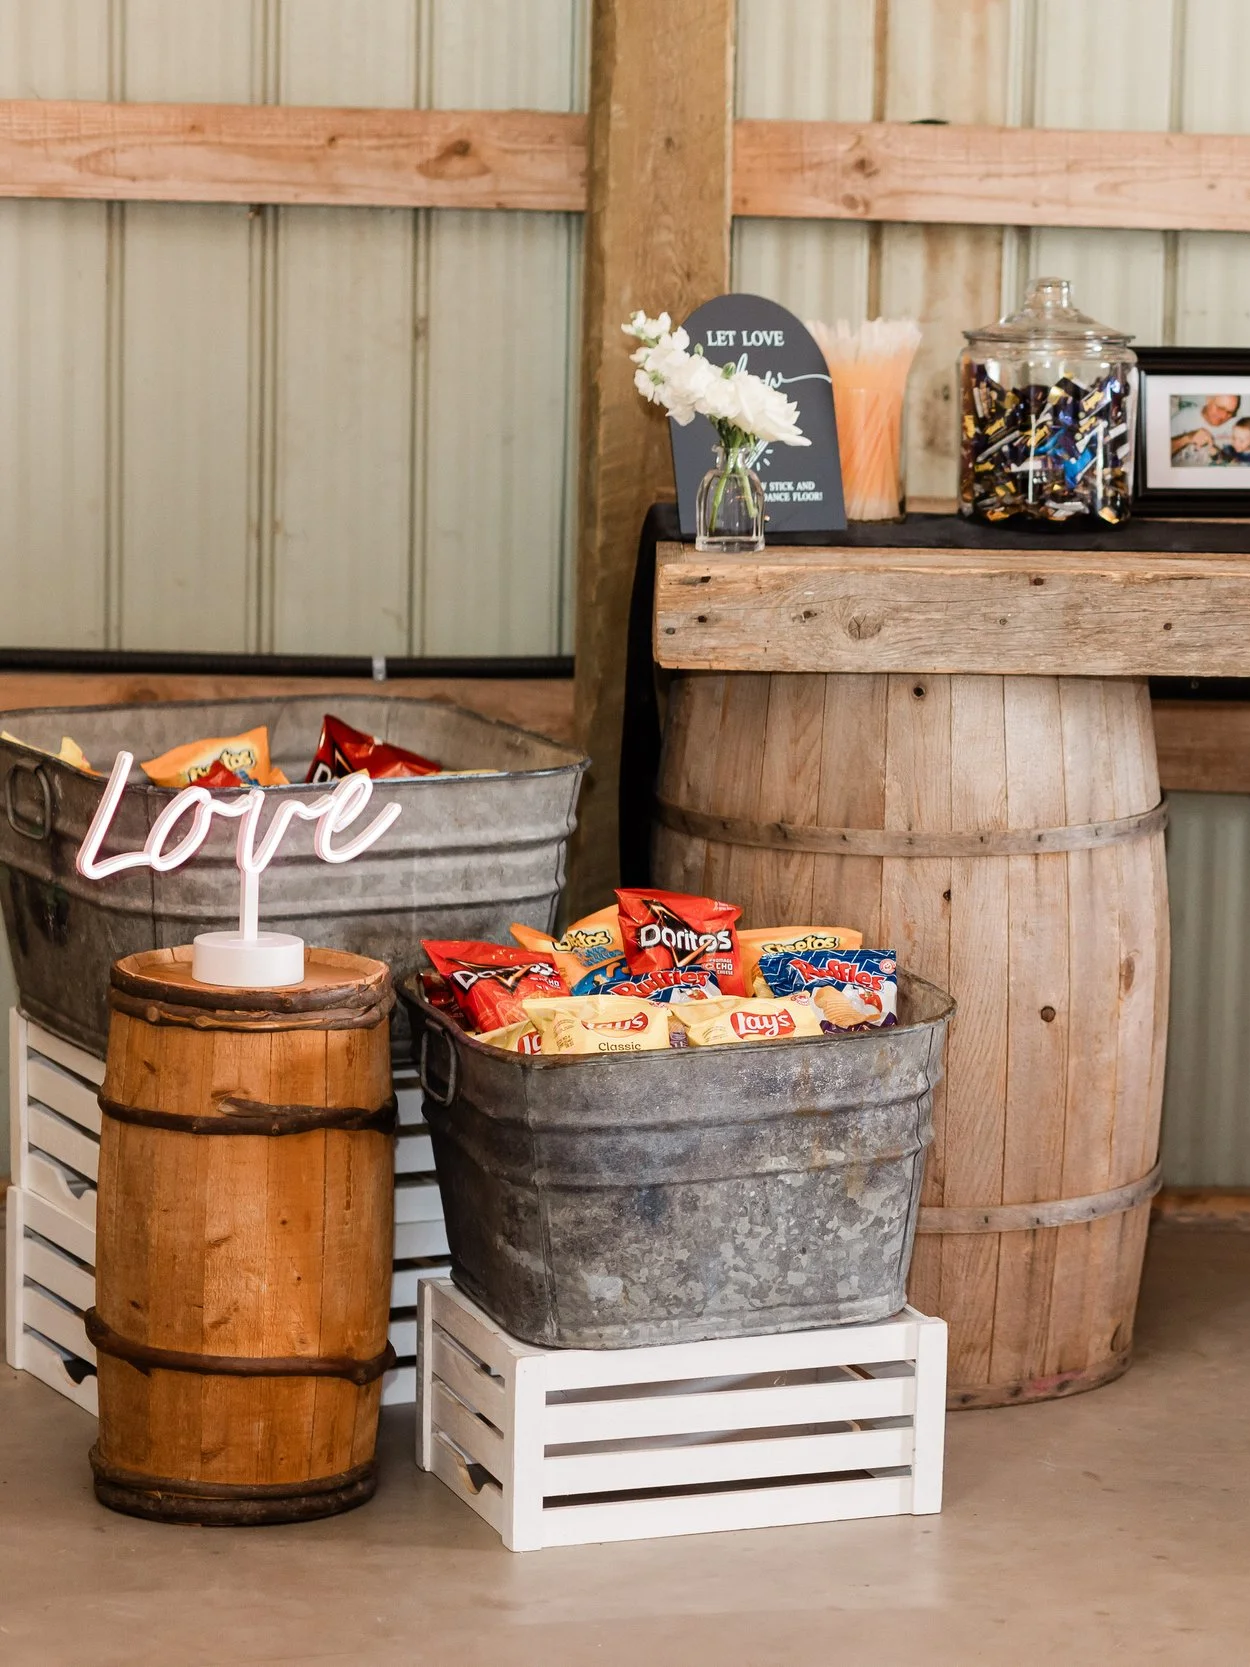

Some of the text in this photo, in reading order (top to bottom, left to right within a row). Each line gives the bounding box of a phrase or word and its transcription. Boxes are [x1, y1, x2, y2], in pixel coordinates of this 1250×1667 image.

[706, 330, 785, 347] LET LOVE
[769, 481, 795, 492] STICK
[796, 480, 816, 491] AND
[792, 491, 824, 502] FLOOR!
[76, 750, 403, 881] Love
[640, 924, 732, 953] Doritos
[762, 935, 838, 954] Cheetos
[608, 970, 711, 998] Ruffles
[790, 958, 885, 991] Ruffles
[736, 1011, 791, 1037] Lay's
[598, 1041, 641, 1052] Classic
